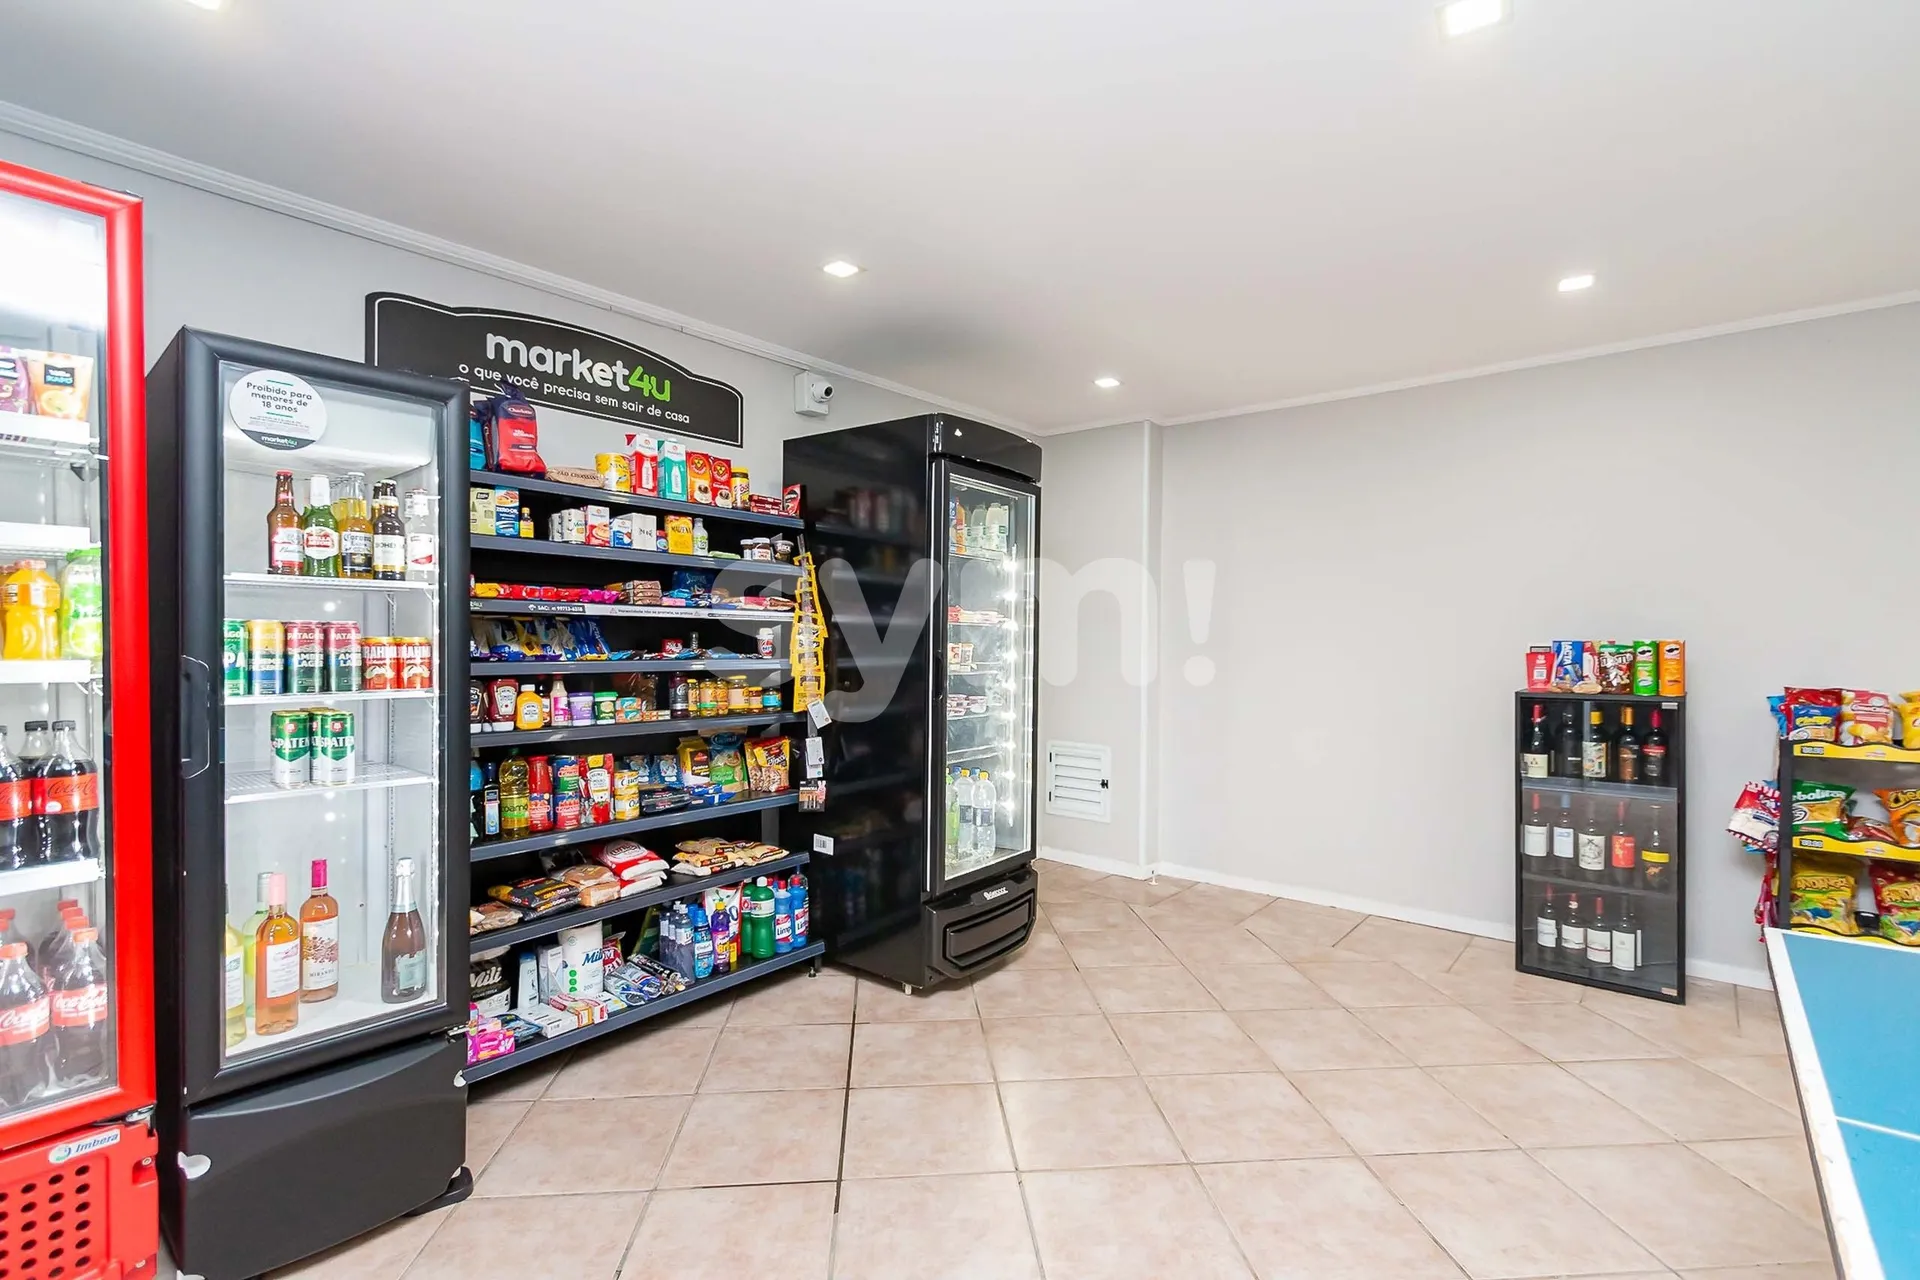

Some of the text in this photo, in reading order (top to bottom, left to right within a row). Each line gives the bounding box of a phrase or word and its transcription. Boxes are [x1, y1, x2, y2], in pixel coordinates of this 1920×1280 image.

[486, 332, 671, 402] market4u
[246, 381, 313, 401] Proibido para
[251, 392, 309, 408] menores de
[459, 363, 690, 424] o que você precisa sem sair de casa
[261, 400, 299, 413] 18 anos
[76, 1133, 119, 1153] Imbera
